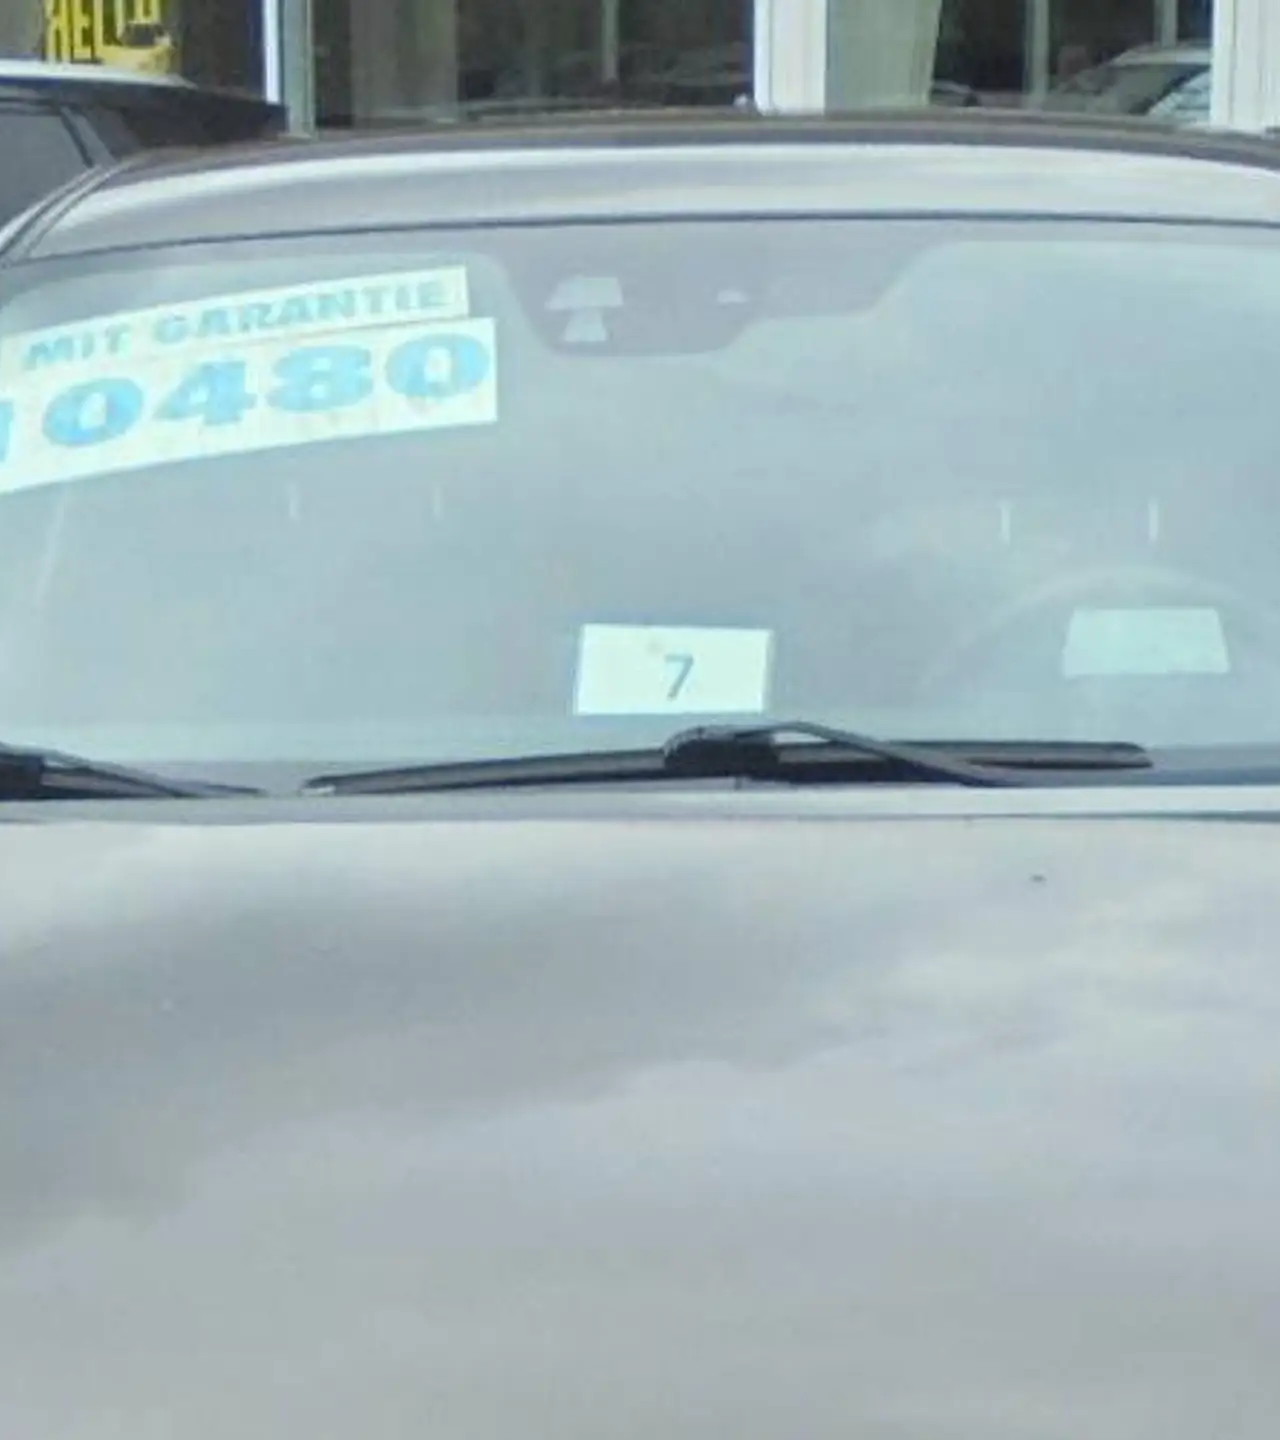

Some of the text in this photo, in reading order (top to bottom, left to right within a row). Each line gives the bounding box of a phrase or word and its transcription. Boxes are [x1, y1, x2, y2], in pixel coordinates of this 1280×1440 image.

[24, 279, 447, 371] MIT GARANTIE
[663, 654, 696, 702] 7
